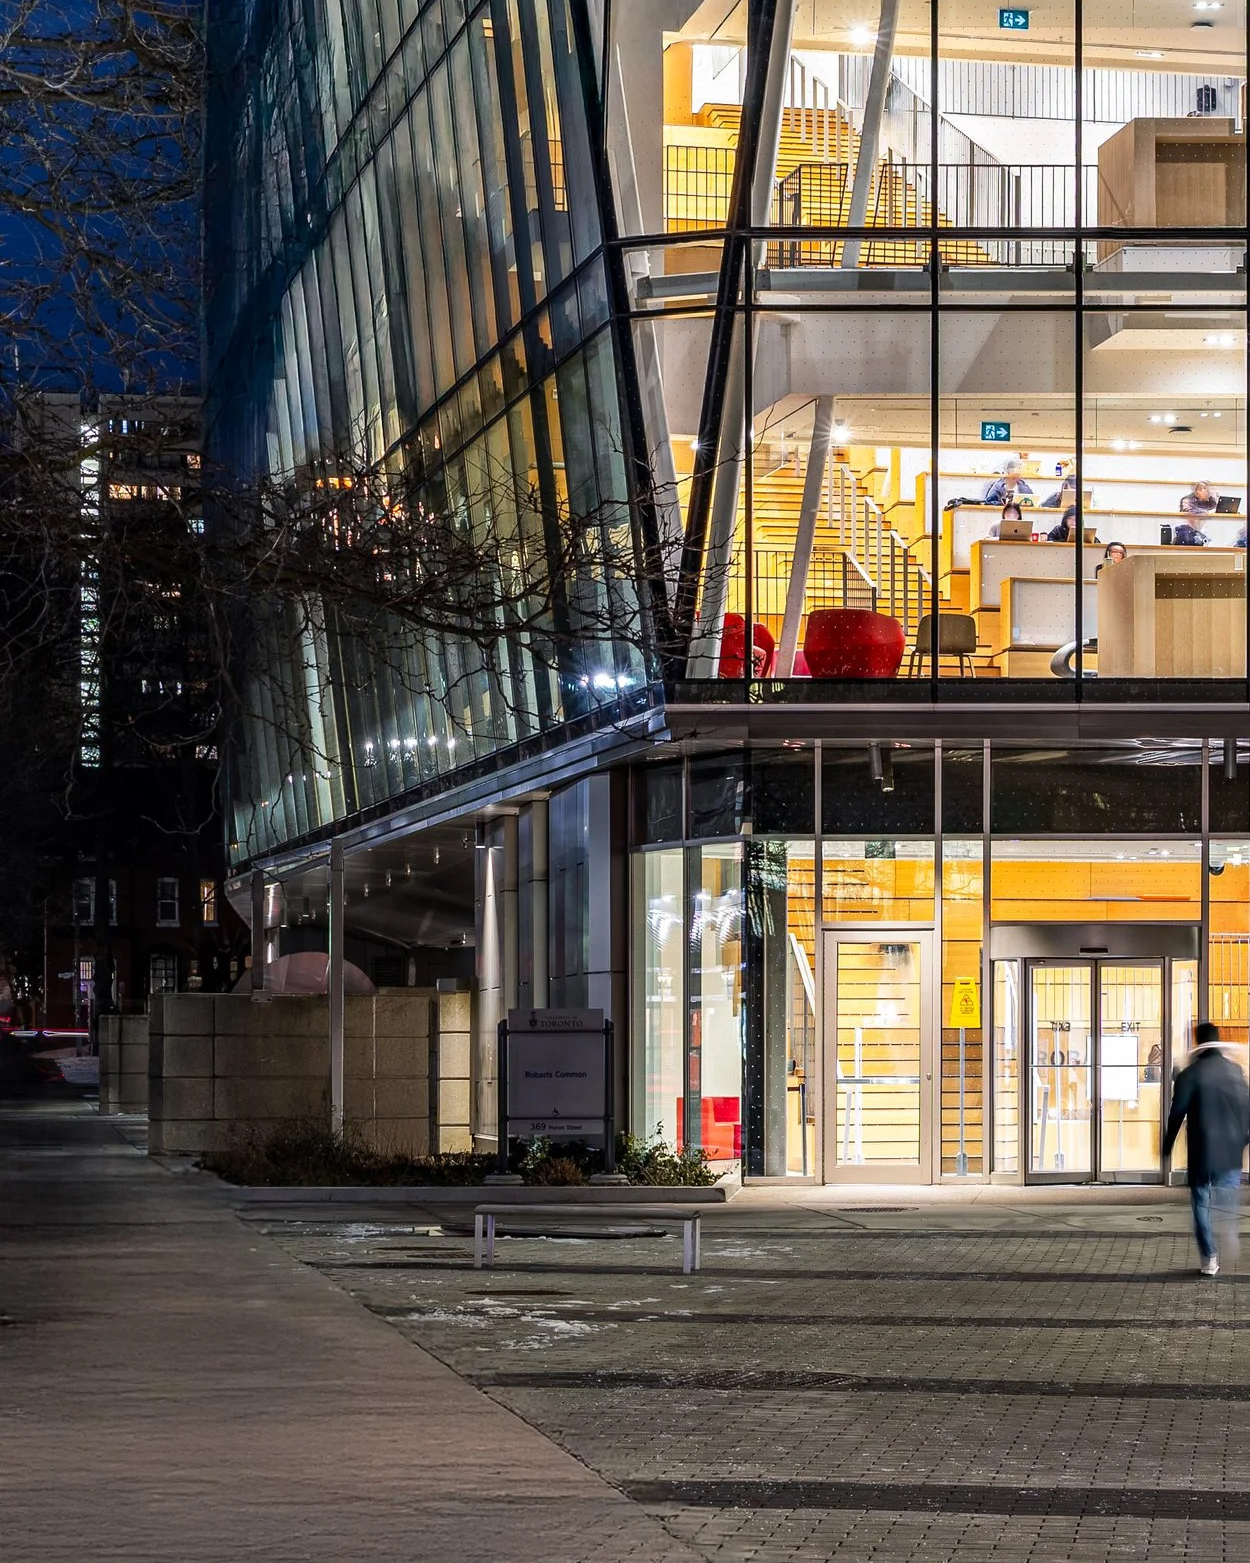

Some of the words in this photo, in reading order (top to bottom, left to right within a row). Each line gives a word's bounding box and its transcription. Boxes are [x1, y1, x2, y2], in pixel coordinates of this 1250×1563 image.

[1120, 1021, 1141, 1032] EXIT
[525, 1071, 553, 1079] Robarts
[555, 1071, 587, 1079] Common
[530, 1123, 547, 1131] 369
